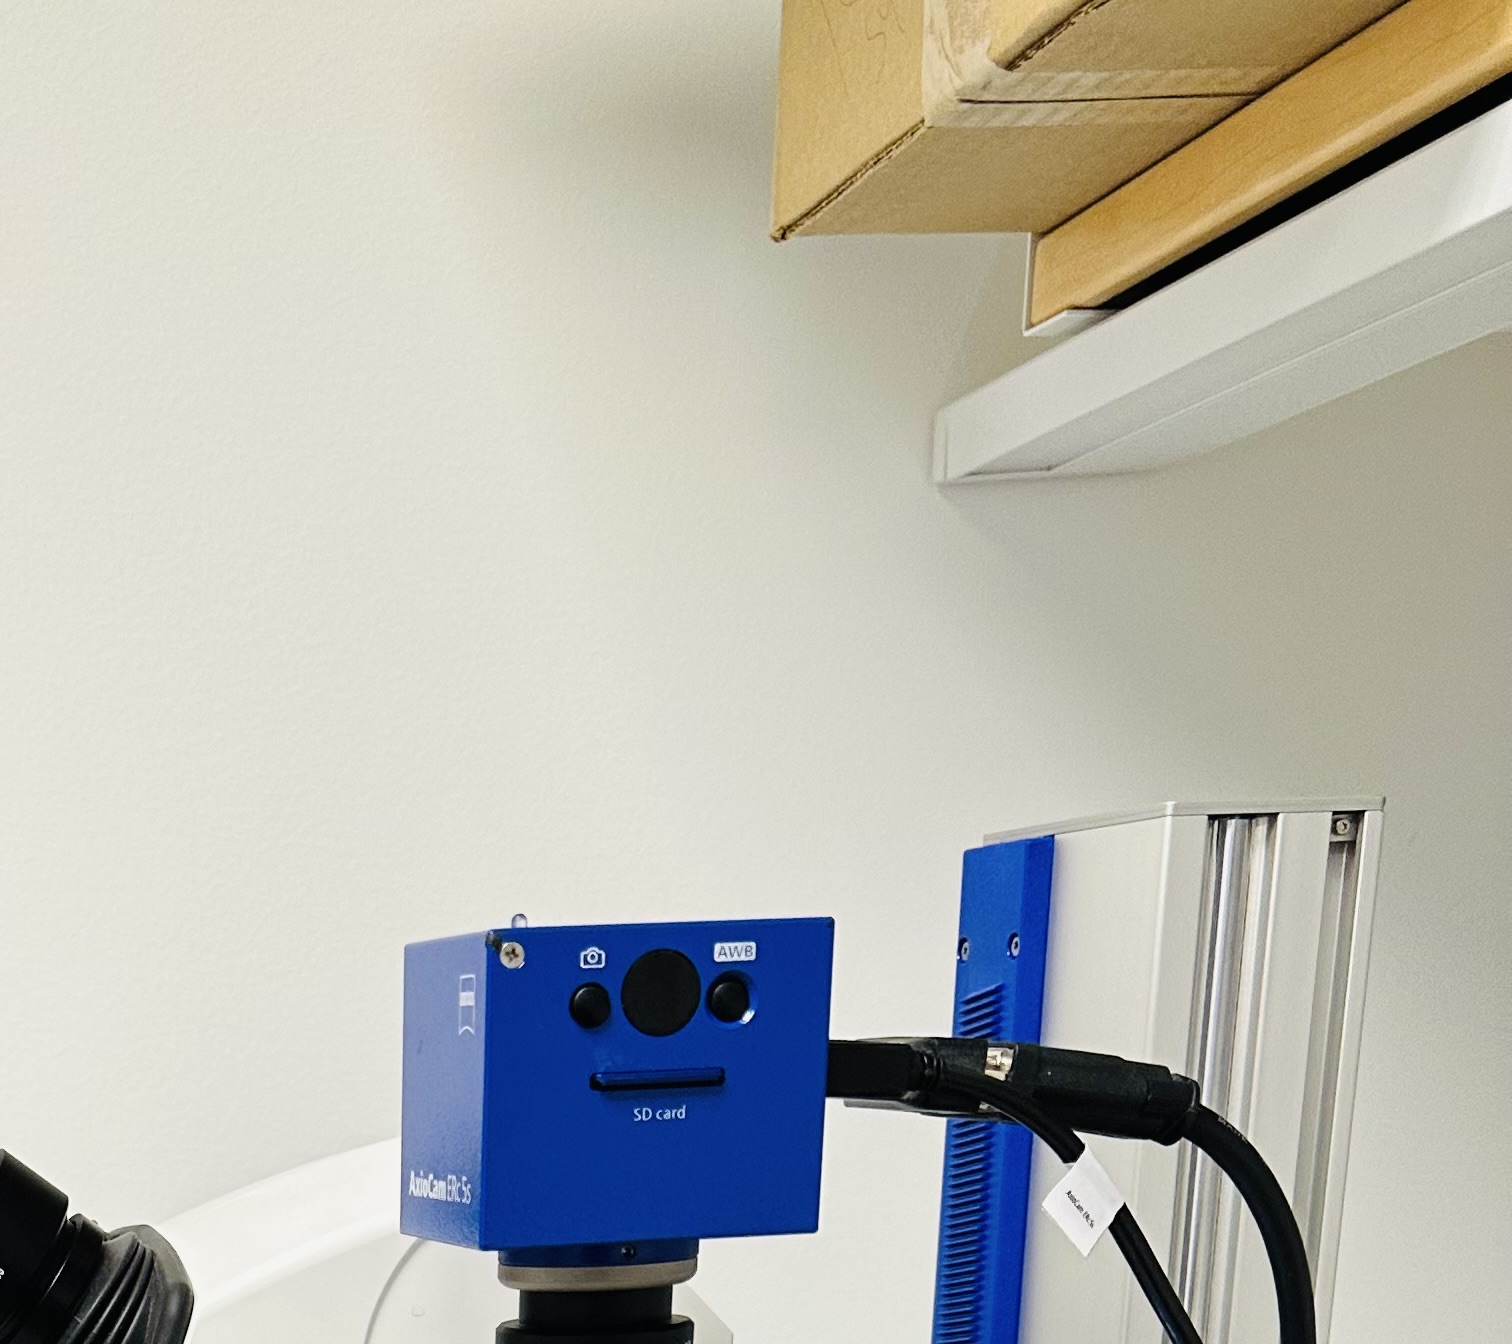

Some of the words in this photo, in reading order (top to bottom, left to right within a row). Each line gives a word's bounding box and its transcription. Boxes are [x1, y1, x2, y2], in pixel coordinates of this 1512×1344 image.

[717, 945, 754, 959] AWB
[633, 1107, 652, 1121] SD
[656, 1104, 686, 1120] card
[408, 1170, 447, 1201] AxioCam
